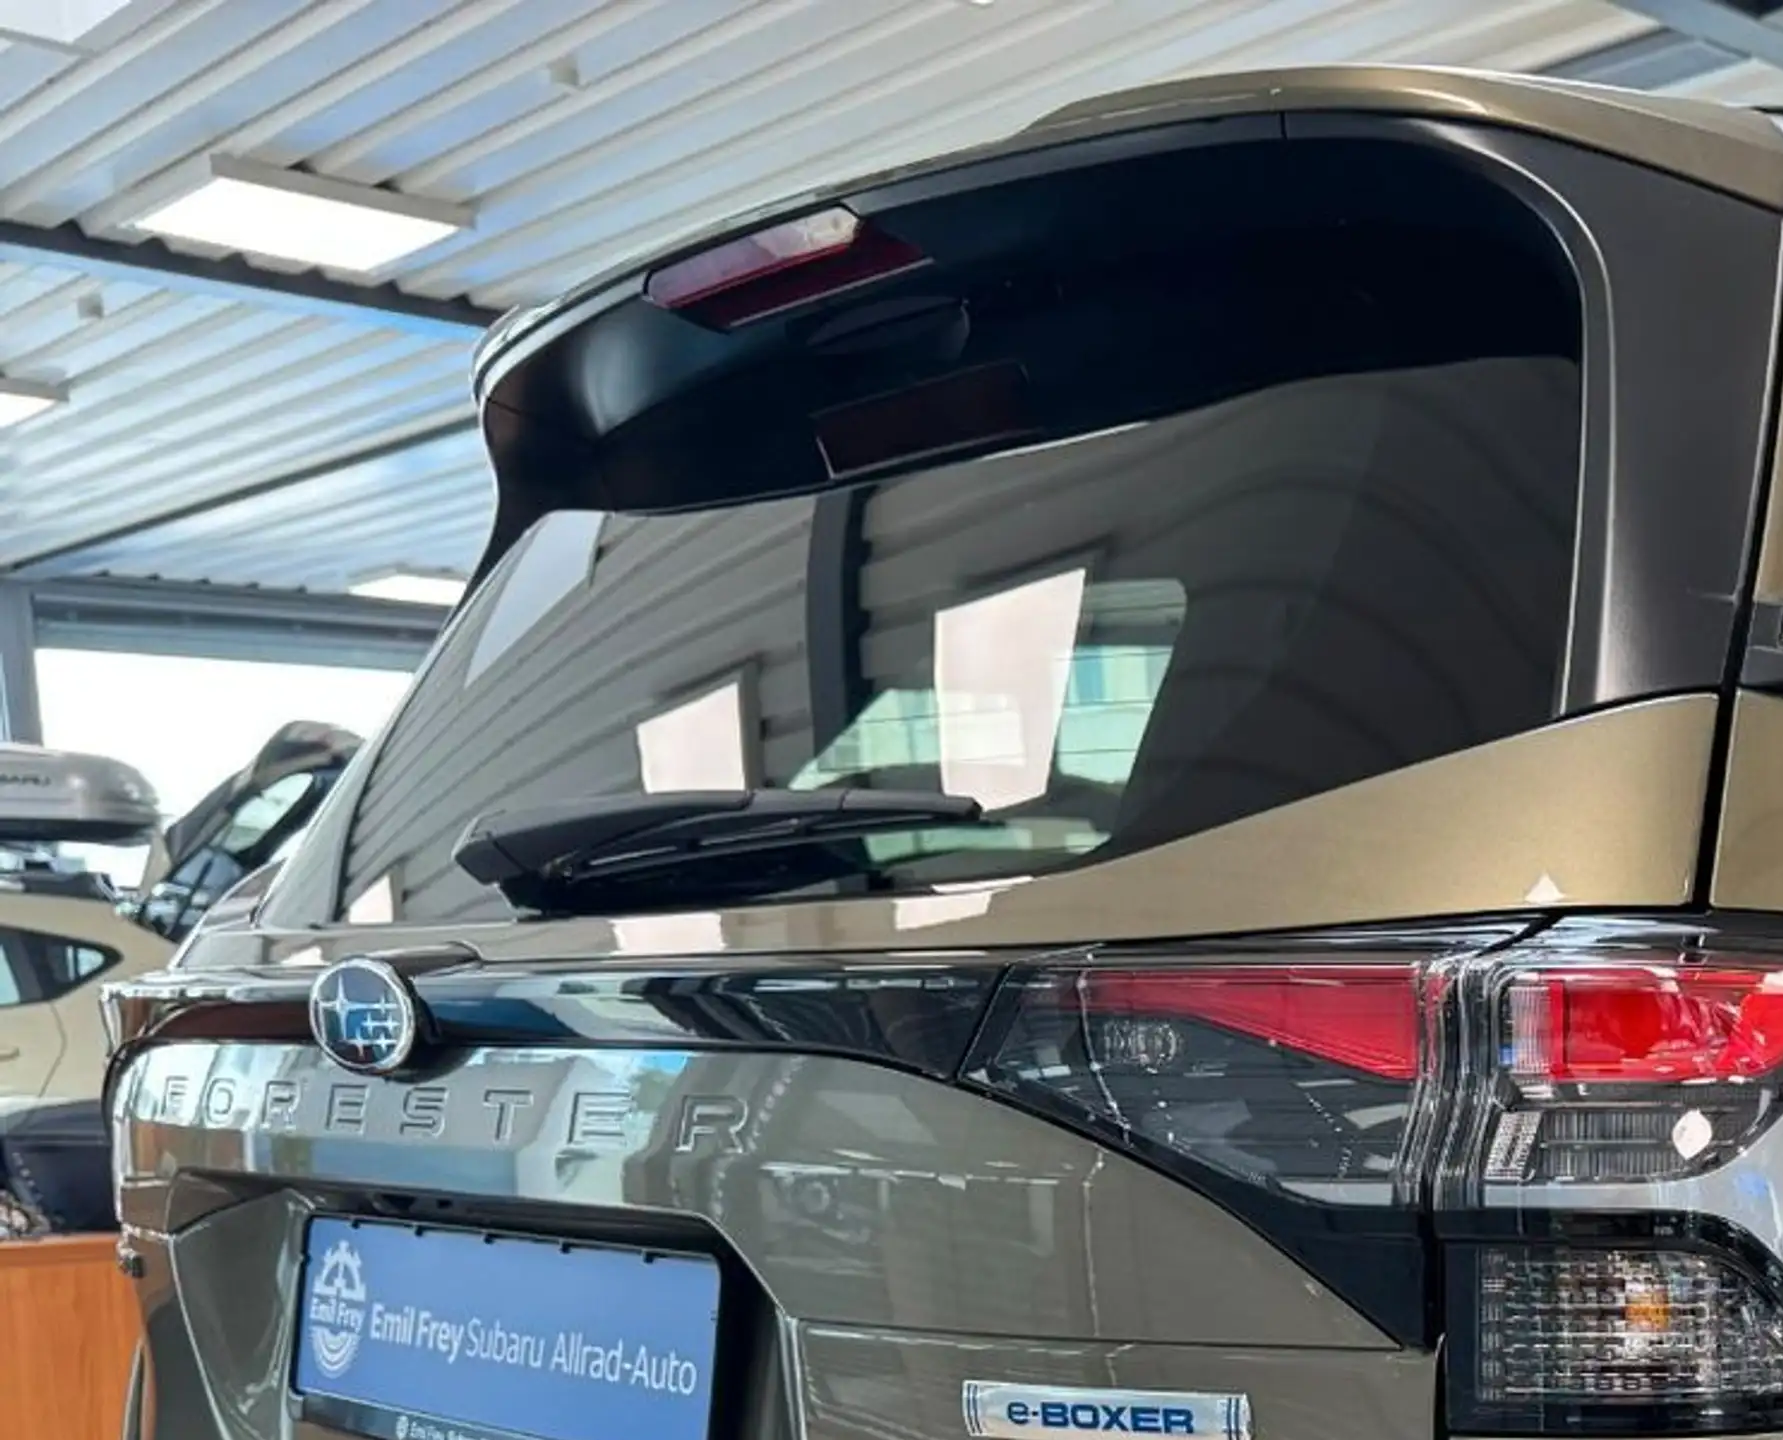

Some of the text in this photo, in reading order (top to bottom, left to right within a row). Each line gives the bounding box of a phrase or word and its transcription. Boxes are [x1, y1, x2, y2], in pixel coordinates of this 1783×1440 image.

[162, 1074, 751, 1154] FORESTER
[369, 1302, 698, 1396] Emil Frey Subaru Allrad-Auto
[1006, 1401, 1195, 1435] e-BOXER
